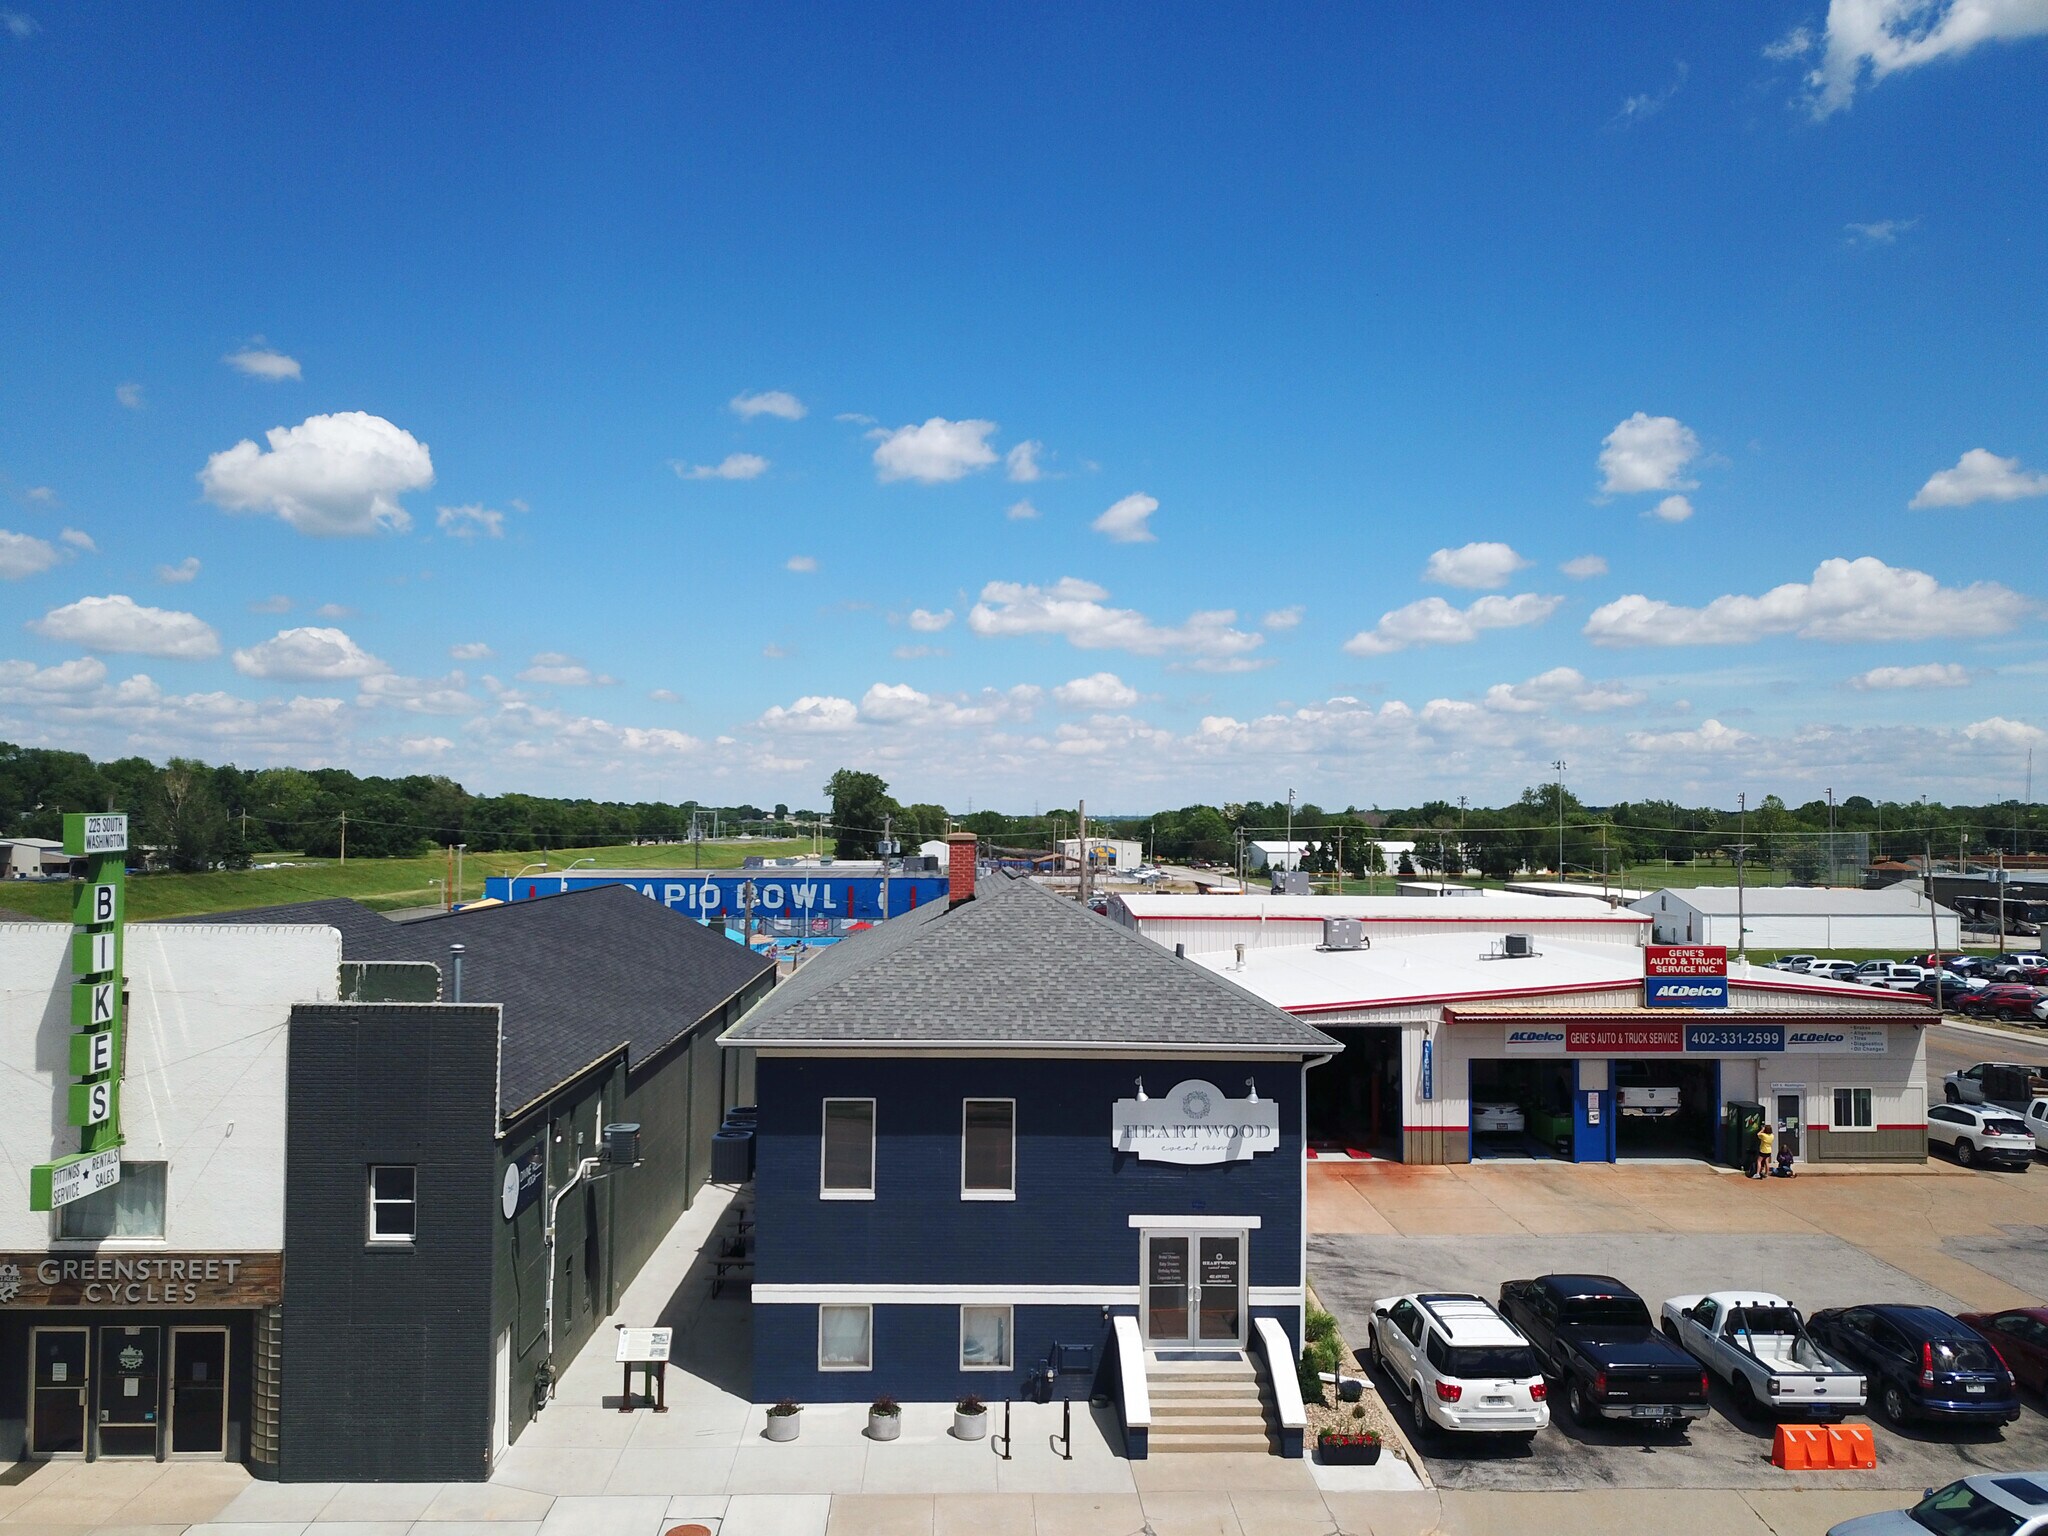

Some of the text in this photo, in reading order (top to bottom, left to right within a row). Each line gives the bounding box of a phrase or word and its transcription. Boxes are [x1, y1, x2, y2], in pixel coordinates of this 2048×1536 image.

[88, 817, 123, 833] 225 SOUTH
[86, 834, 125, 849] WASHINGTON
[624, 882, 837, 909] APIO BOWL
[1668, 949, 1704, 957] GENE'S
[1650, 957, 1723, 965] AUTO & TRUCK
[1655, 965, 1696, 973] SERVICE
[1655, 985, 1723, 996] ACDelco
[92, 886, 113, 1119] BIKES
[1509, 1032, 1564, 1041] ACDelco
[1570, 1032, 1679, 1045] GENE'S AUTO & TRUCK SERVICE
[1691, 1032, 1780, 1044] 402-331-2599
[1789, 1032, 1844, 1042] ACDelco
[1123, 1124, 1271, 1139] HEARTWOOD
[1161, 1141, 1198, 1152] event
[92, 1149, 118, 1171] RENTALS
[53, 1163, 80, 1187] FITTINGS
[95, 1168, 115, 1188] SALES
[53, 1181, 80, 1205] SERVICE
[37, 1259, 242, 1285] GREENSTREET
[85, 1283, 198, 1303] CYCLES
